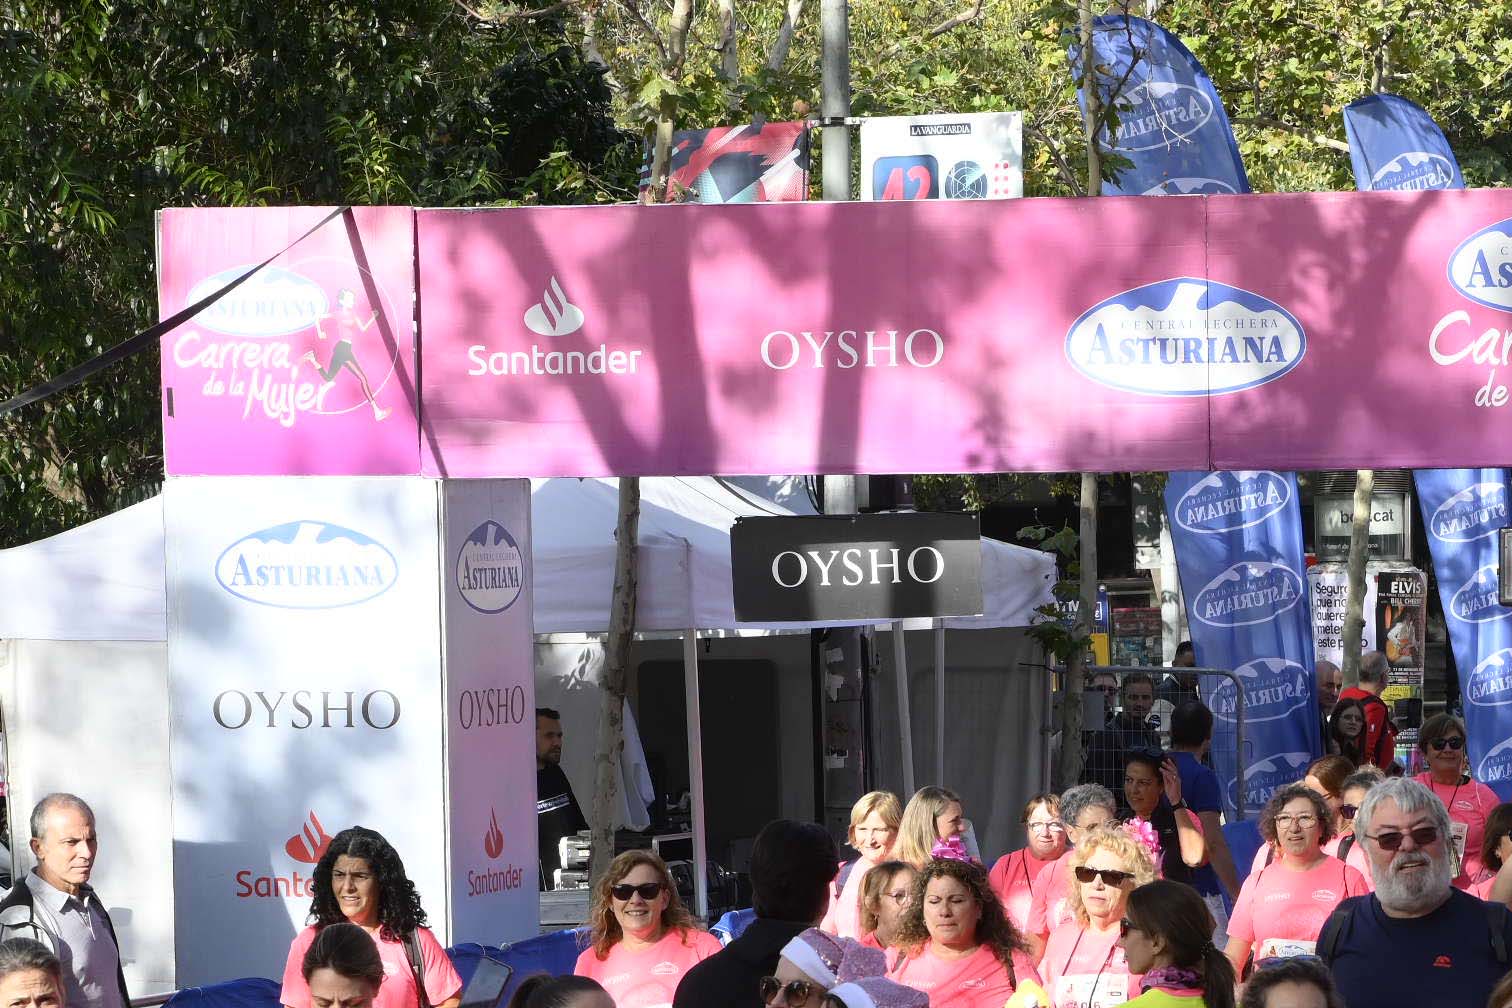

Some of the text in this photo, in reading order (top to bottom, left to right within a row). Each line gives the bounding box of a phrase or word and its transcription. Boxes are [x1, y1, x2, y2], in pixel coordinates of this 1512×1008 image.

[923, 124, 971, 134] VANGUARDIA
[173, 334, 293, 375] Carrera
[467, 343, 643, 376] Santander
[760, 328, 945, 370] OYSHO
[1087, 322, 1288, 366] ASTURIANA
[201, 365, 337, 427] de la Mujer
[1473, 374, 1510, 408] de
[229, 552, 385, 588] ASTURIANA
[461, 562, 520, 592] ASTURIANA
[771, 545, 946, 589] OYSHO
[1316, 598, 1333, 611] que
[1391, 582, 1422, 594] ELVIS
[1317, 638, 1336, 648] este
[211, 689, 402, 730] OYSHO
[458, 684, 526, 730] OYSHO
[467, 863, 524, 898] Santander
